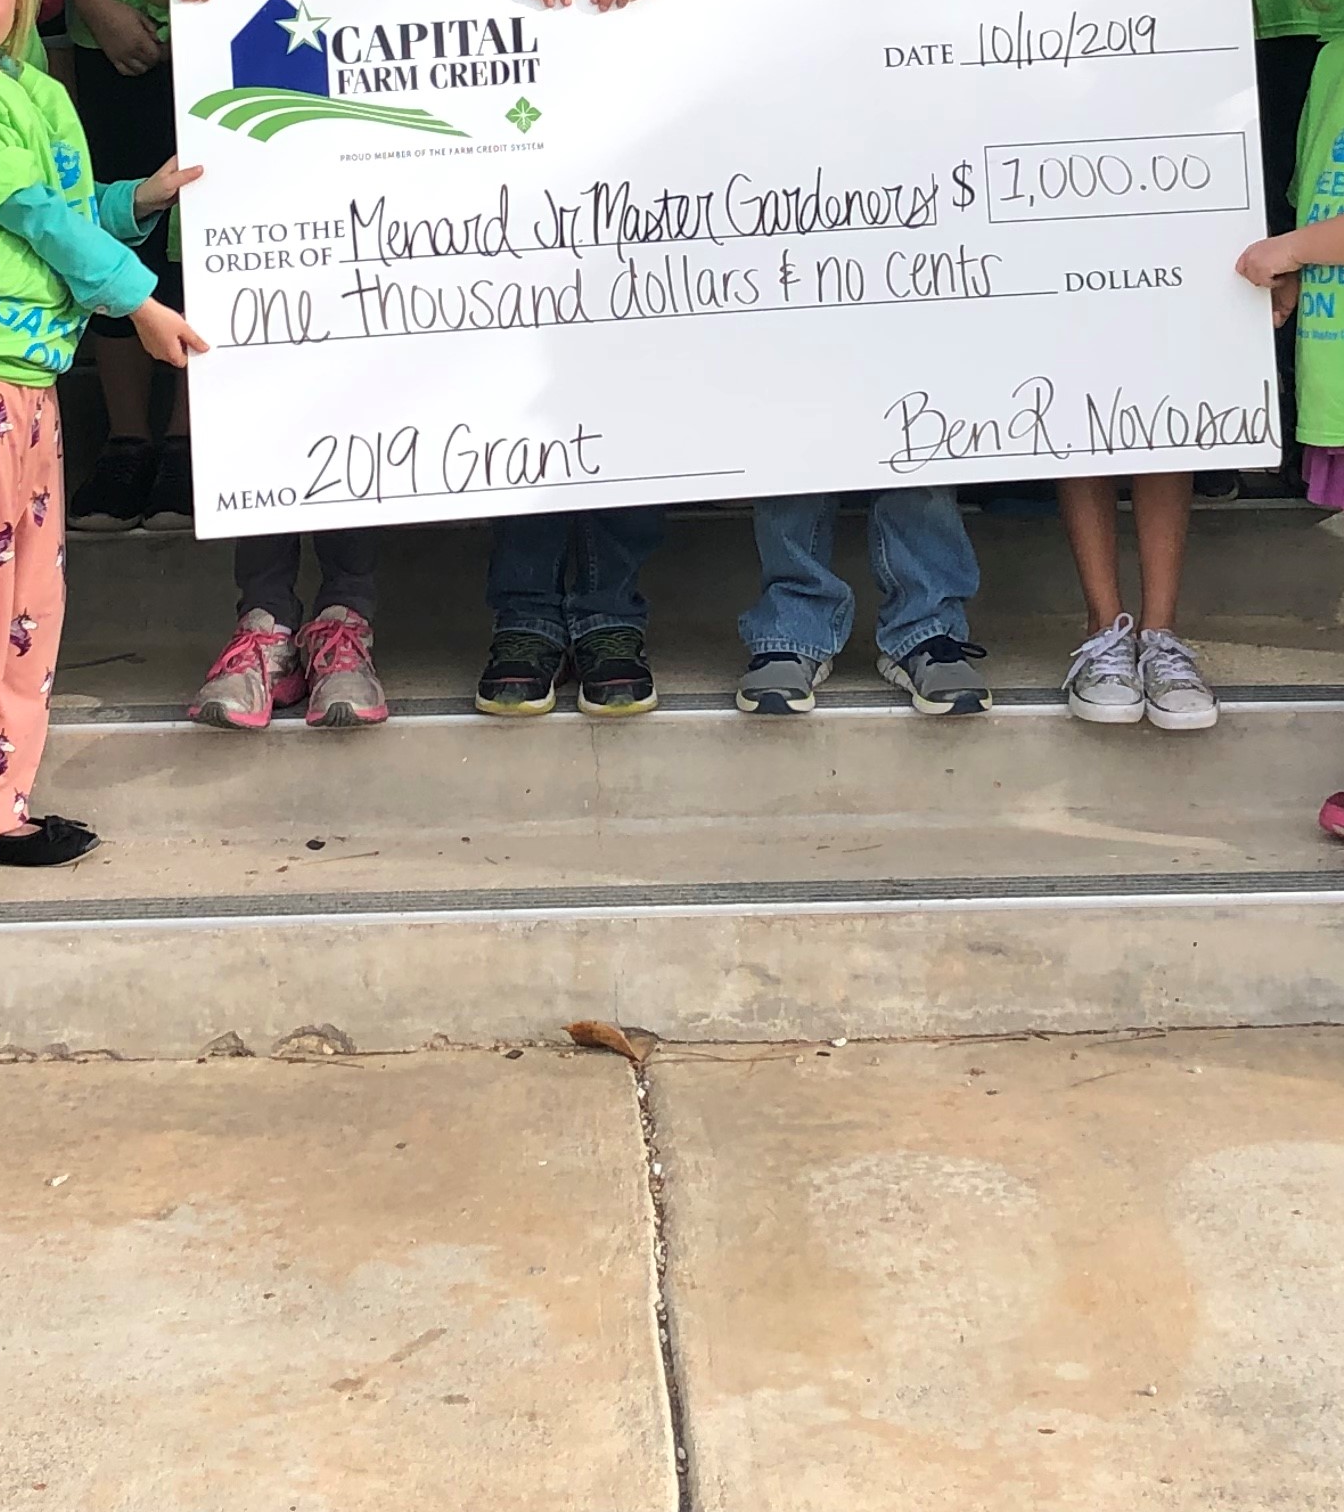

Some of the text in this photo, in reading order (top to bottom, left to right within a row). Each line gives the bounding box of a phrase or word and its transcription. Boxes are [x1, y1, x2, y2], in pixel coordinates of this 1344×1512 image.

[332, 16, 538, 65] CAPITAL
[883, 43, 954, 68] DATE
[979, 11, 1157, 69] 10/10/2019
[337, 57, 541, 95] FARM CREDIT
[340, 142, 545, 162] PROUD MEMBER OF THE FARM CREDIT SYSTEM
[952, 159, 974, 213] $
[1000, 154, 1212, 209] 1,000.00
[205, 219, 346, 248] PAY TO THE
[350, 184, 523, 266] Menard
[580, 180, 726, 262] Master
[205, 247, 333, 274] ORDER OF
[1064, 266, 1184, 293] DOLLARS
[230, 287, 331, 345] one
[342, 268, 594, 336] thousand
[610, 255, 760, 320] dollars
[816, 265, 865, 304] no
[886, 244, 1003, 297] cents
[884, 390, 1002, 474] Ben
[1086, 379, 1283, 456] Novosad
[303, 423, 603, 503] 2019 Grant
[216, 486, 297, 512] MEMO
